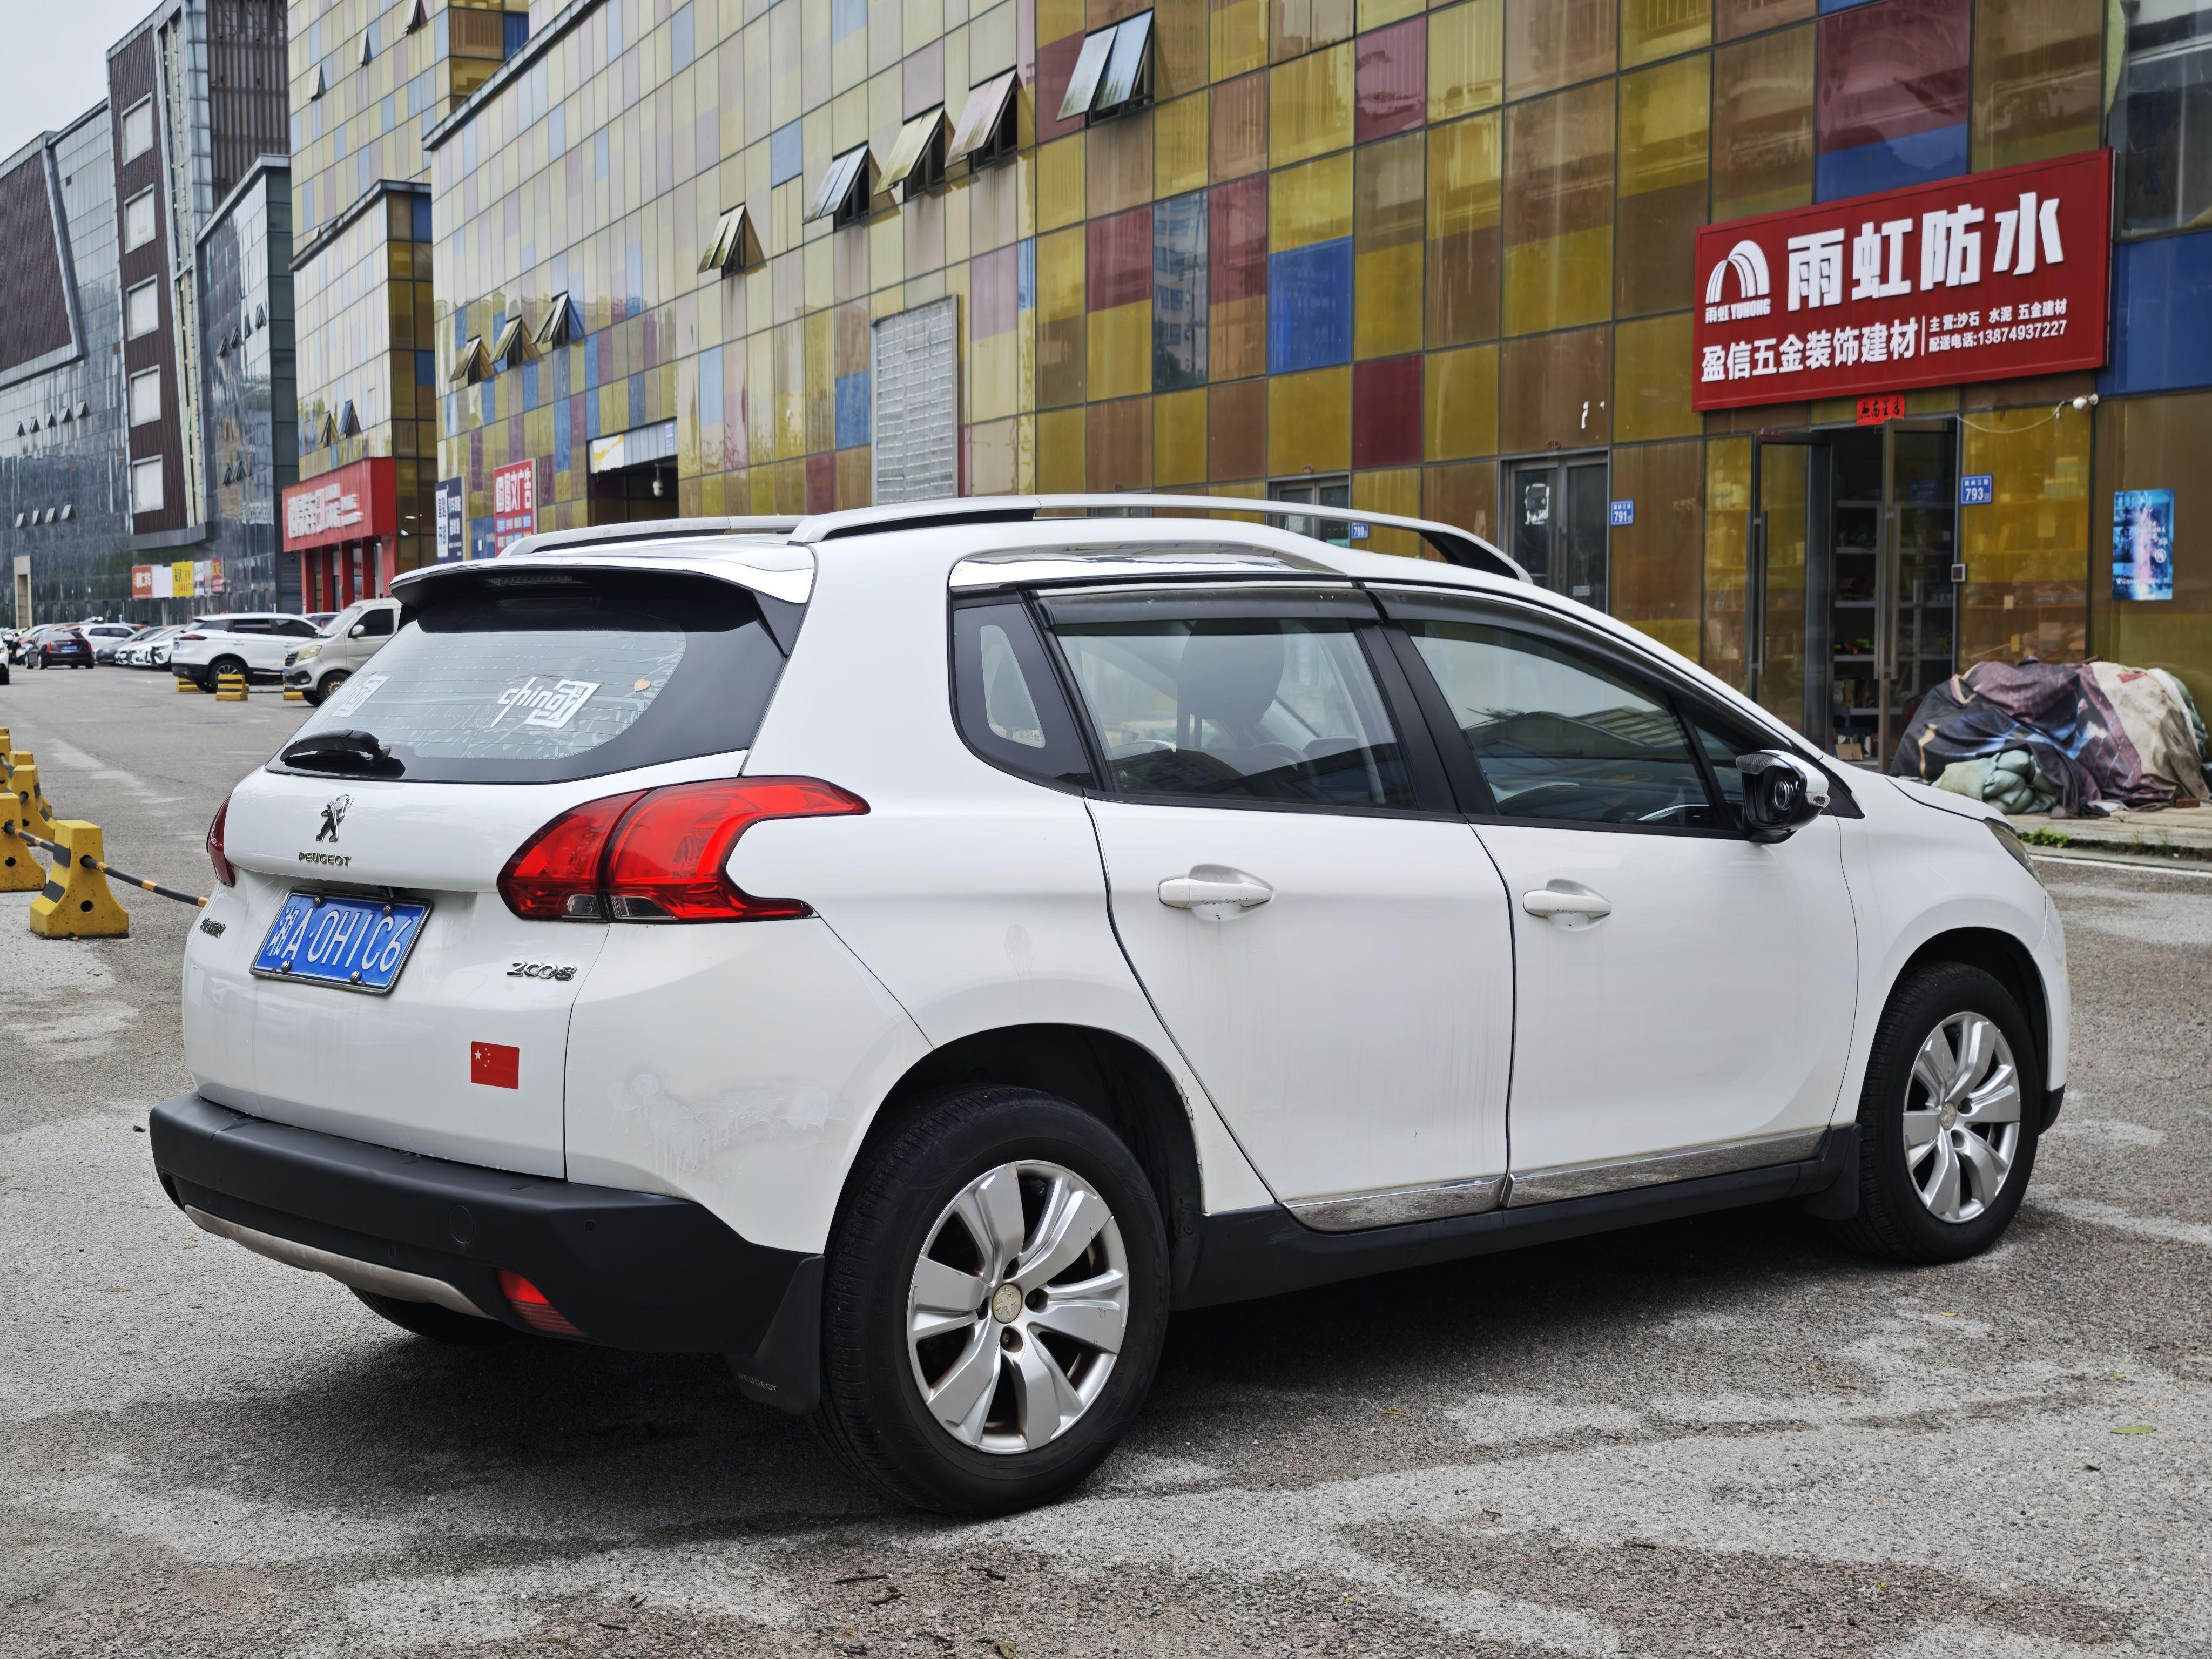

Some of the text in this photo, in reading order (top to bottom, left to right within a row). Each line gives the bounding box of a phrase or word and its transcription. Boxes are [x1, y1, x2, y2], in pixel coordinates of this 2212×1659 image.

[1787, 191, 2064, 312] 雨虹防水
[1705, 298, 1771, 323] 雨虹 YUHONG
[1988, 306, 2013, 324] 水泥
[2018, 298, 2067, 320] 五金建材
[1701, 317, 1918, 382] 盈信五金装饰建材
[1965, 487, 1984, 501] 793
[1614, 510, 1627, 522] 791
[298, 851, 352, 867] PEUGEOT
[507, 960, 577, 981] 2008
[738, 1372, 778, 1392] PEUGEOT
